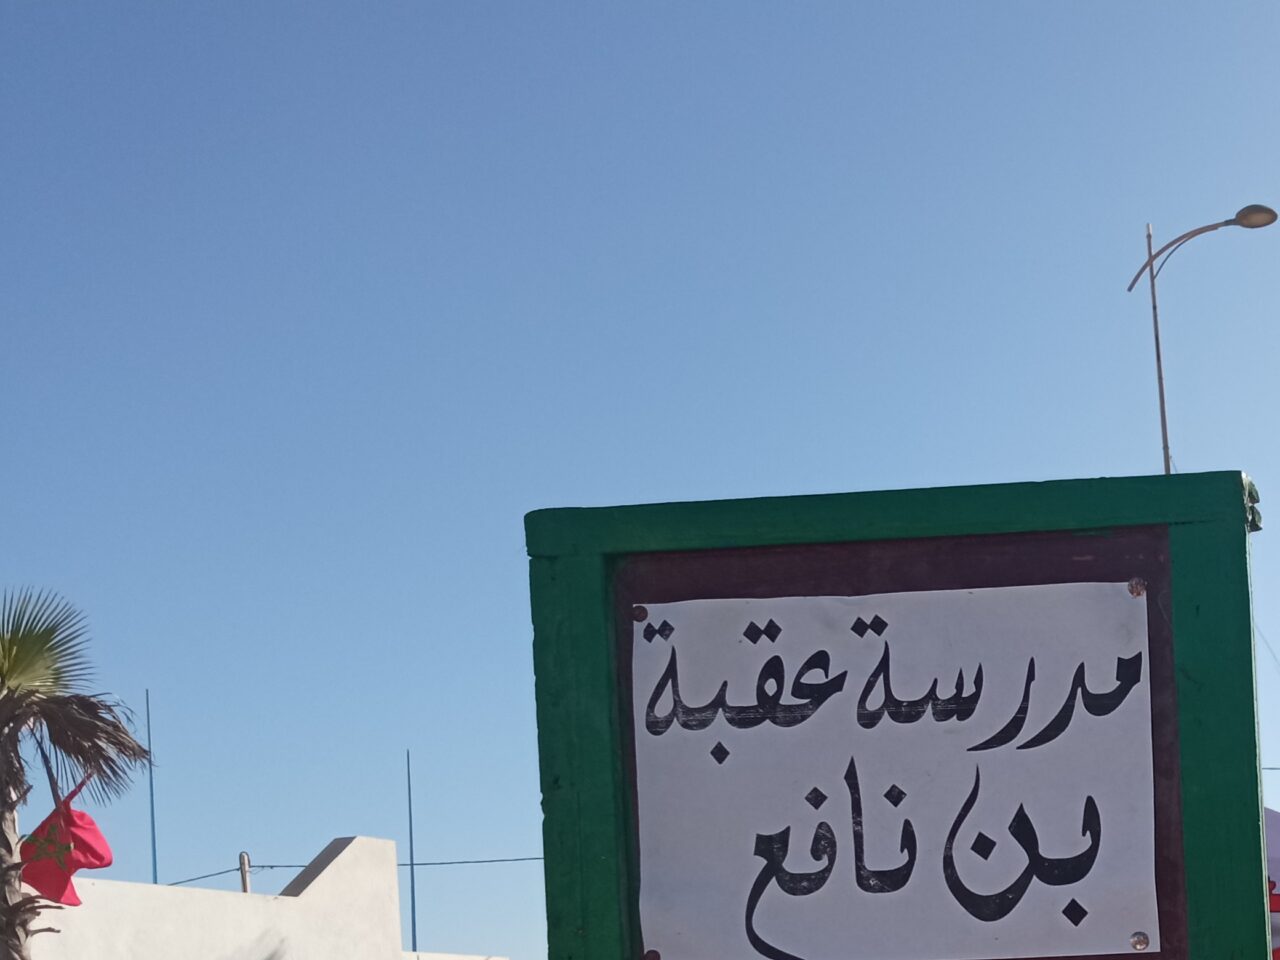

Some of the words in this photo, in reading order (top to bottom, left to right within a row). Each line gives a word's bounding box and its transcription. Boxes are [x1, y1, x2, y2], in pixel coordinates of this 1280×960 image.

[643, 618, 848, 765] عقبة
[851, 614, 1143, 752] مدرسة
[942, 763, 1102, 927] بن
